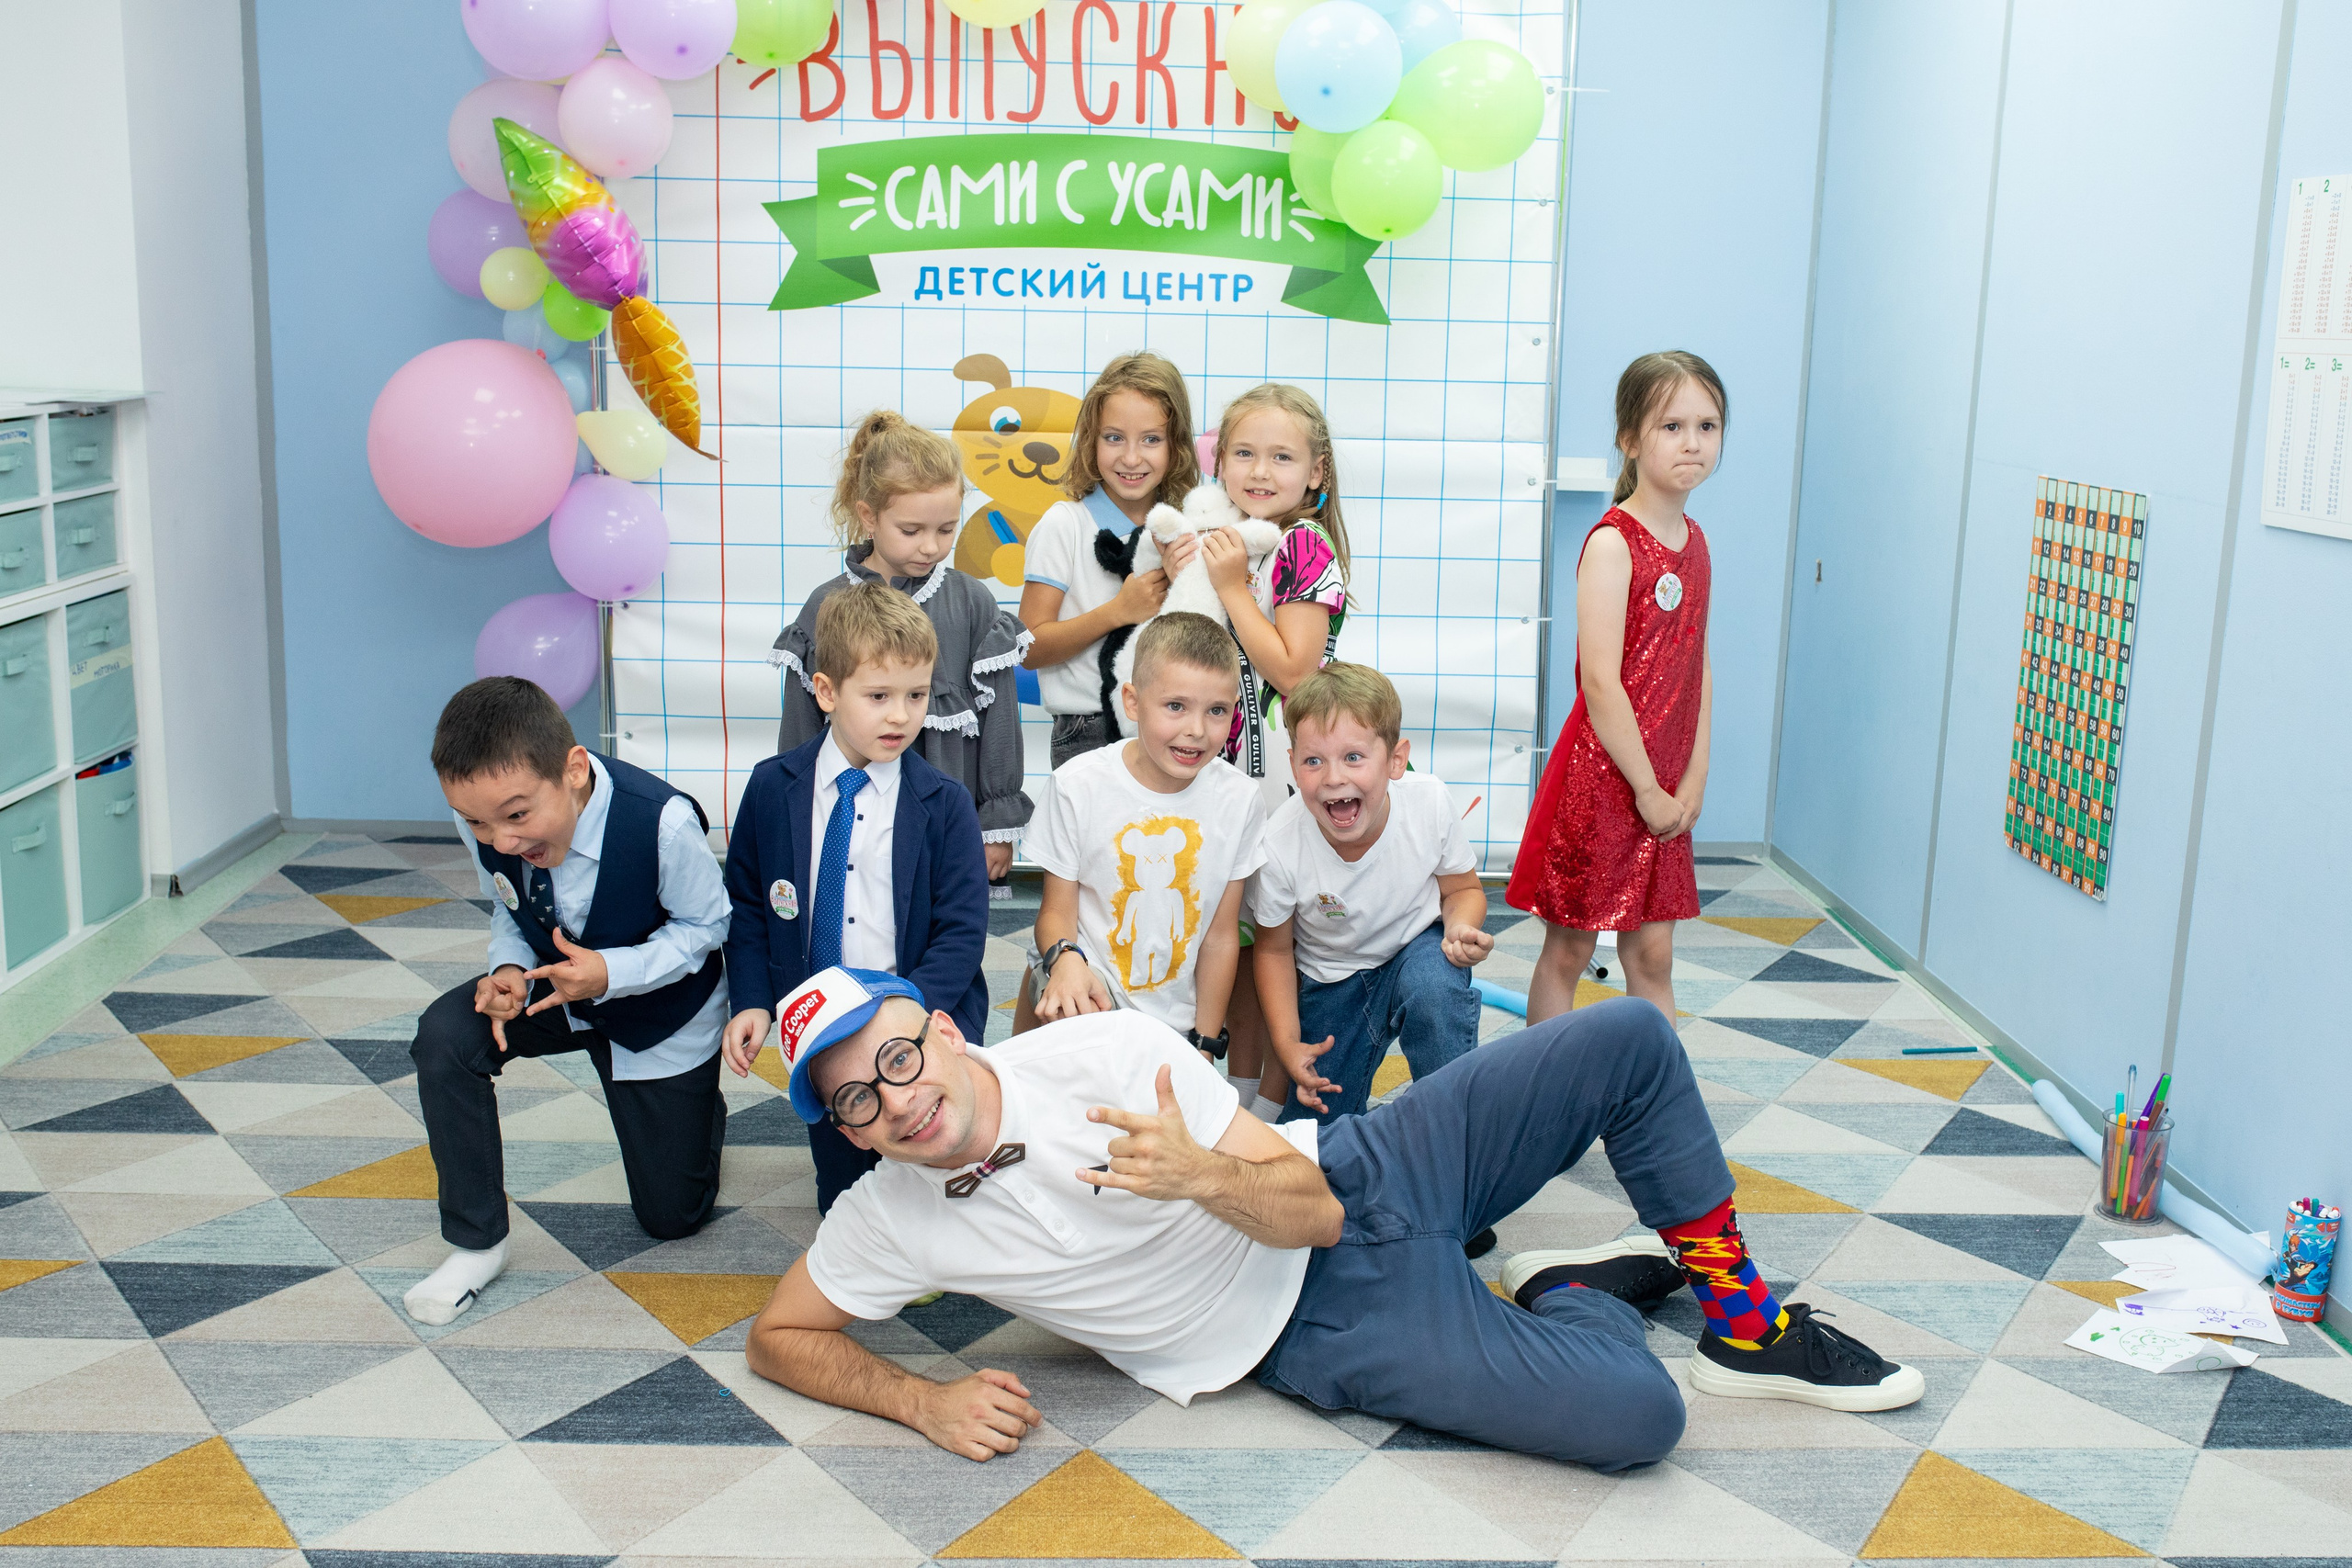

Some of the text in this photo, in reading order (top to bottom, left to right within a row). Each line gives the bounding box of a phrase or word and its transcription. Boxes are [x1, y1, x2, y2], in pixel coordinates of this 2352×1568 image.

[885, 160, 1284, 243] САМИ С УСАМИ
[2299, 179, 2330, 195] 1 2
[914, 262, 1255, 306] ДЕТСКИЙ ЦЕНТР
[2047, 505, 2052, 516] 2
[2057, 506, 2062, 518] 3
[2067, 509, 2072, 520] 4
[2078, 511, 2083, 523] 5
[2089, 513, 2093, 525] 6
[2100, 516, 2105, 527] 7
[2111, 518, 2116, 530] 8
[2123, 521, 2127, 532] 9
[2134, 523, 2142, 535] 10
[2034, 541, 2137, 577] 11 12 13 14 15 16 17 18 19 20
[2030, 578, 2133, 618] 21 22 23 24 25 26 27 28 29 30
[2026, 615, 2128, 659] 31 32 33 34 35 36 37 38 39 40
[1244, 674, 1258, 726] GULLIVER
[2022, 653, 2124, 700] 41 42 43 44 45 46 47 48 49 50
[2019, 690, 2120, 741] 51 52 53 54 55 56 57 58 59 60
[2015, 726, 2115, 781] 61 62 63 64 65 66 67 68 69 70
[2012, 762, 2111, 821] 71 72 73 74 75 76 77 78 79 80
[2008, 800, 2107, 861] 81 82 83 84 85 86 87 88 89 90
[2013, 841, 2020, 853] 92
[2023, 846, 2029, 858] 93
[2032, 852, 2039, 864] 94
[2042, 858, 2049, 870] 95
[2052, 864, 2059, 876] 96
[2062, 869, 2069, 881] 97
[2073, 875, 2080, 888] 98
[2083, 881, 2091, 894] 99
[785, 993, 819, 1034] Cooper
